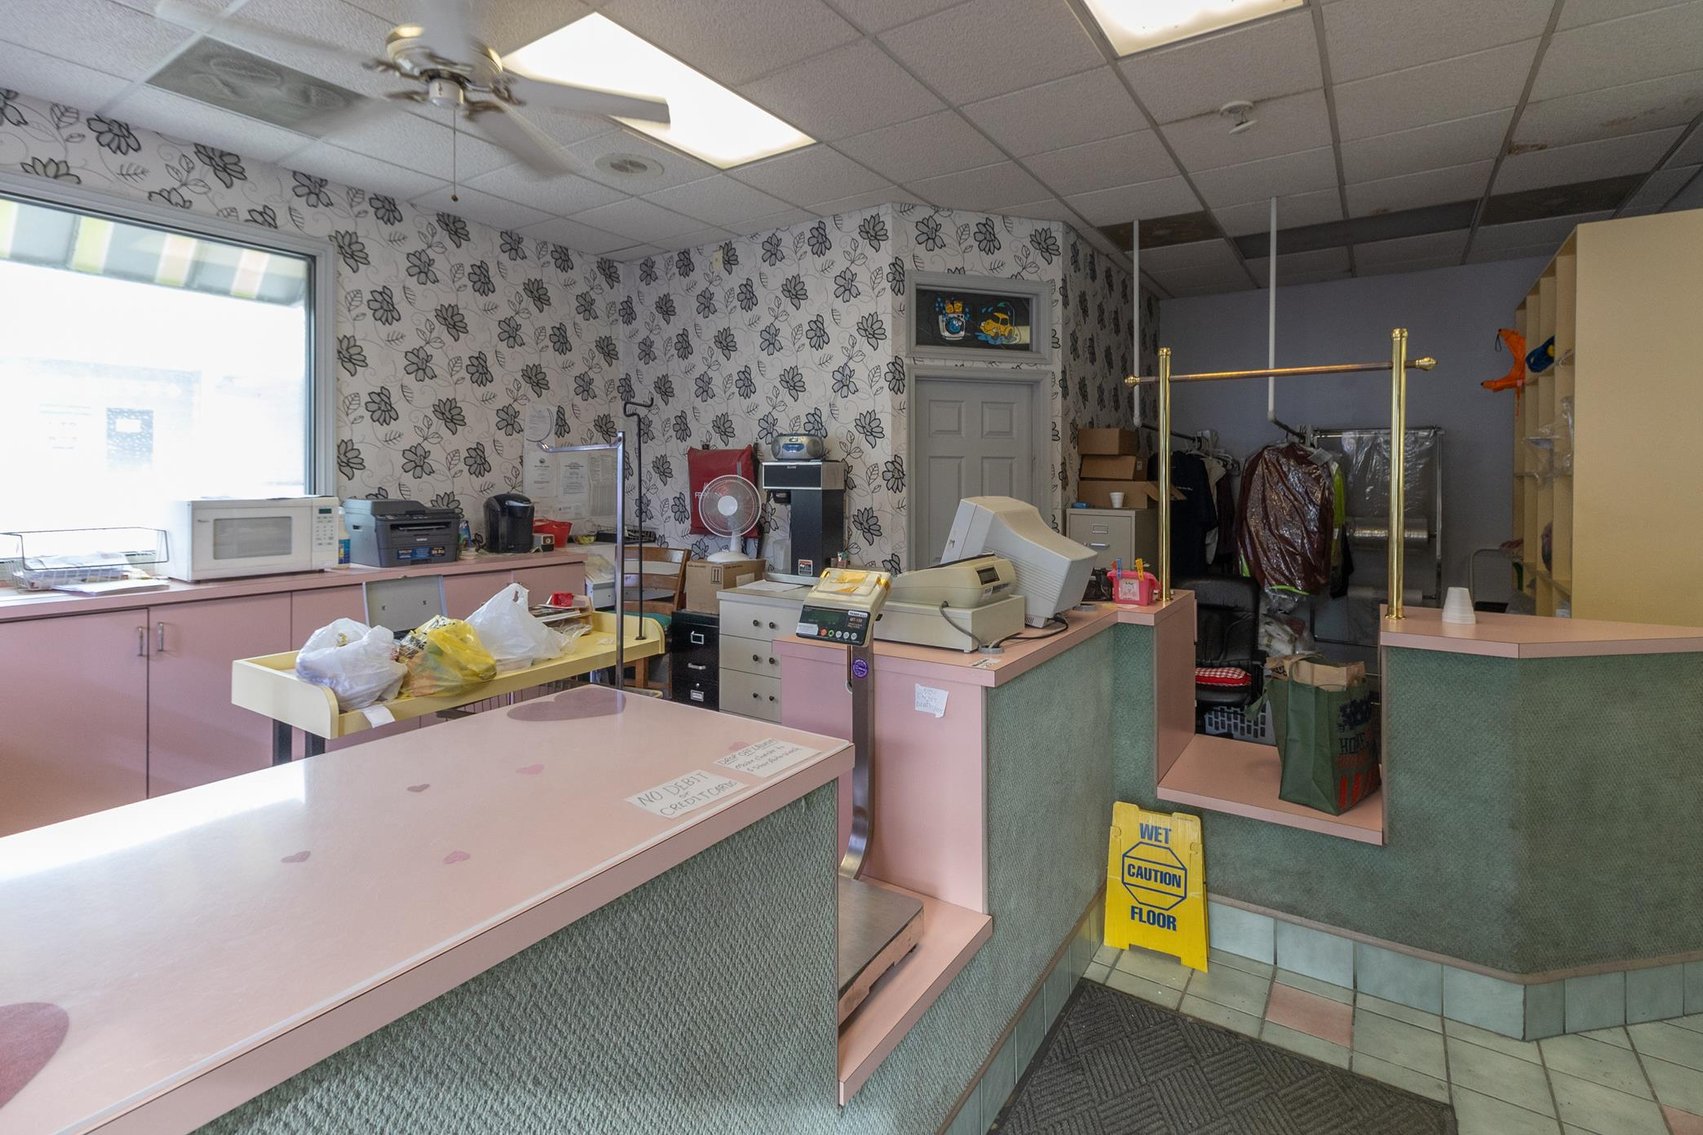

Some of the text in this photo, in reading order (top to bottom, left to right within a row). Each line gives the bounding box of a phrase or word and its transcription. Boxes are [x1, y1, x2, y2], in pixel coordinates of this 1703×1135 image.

[637, 772, 709, 807] NO DEBIT
[660, 791, 710, 816] CREDIT
[1139, 823, 1172, 844] WET
[1127, 864, 1182, 888] CAUTION
[1130, 906, 1177, 931] FLOOR
